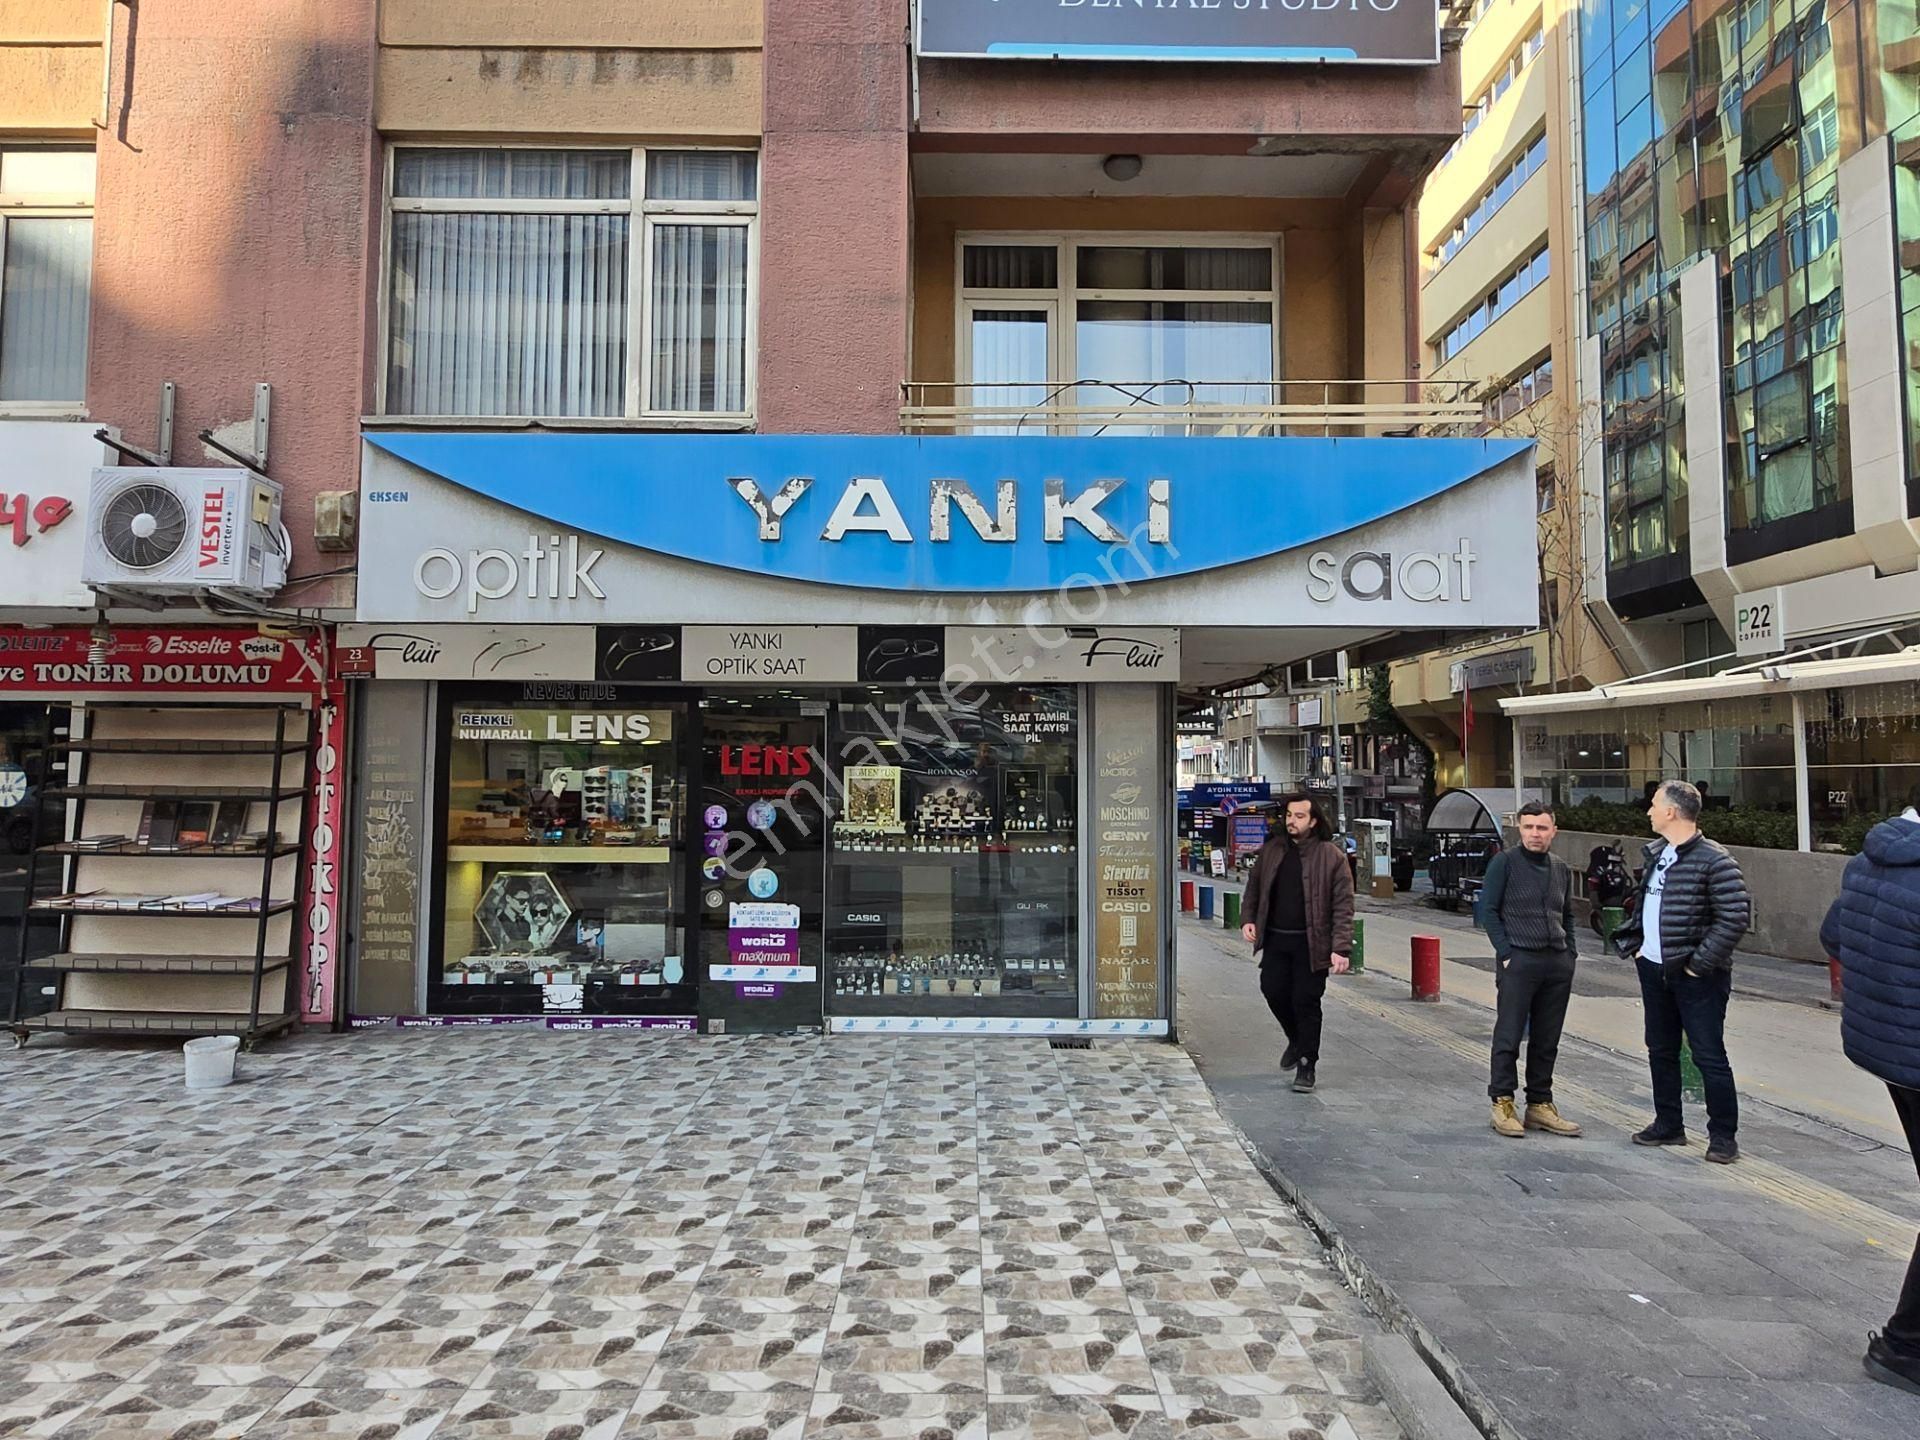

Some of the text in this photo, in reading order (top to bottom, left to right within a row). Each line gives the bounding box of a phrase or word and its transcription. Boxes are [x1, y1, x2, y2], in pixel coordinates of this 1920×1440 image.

[368, 491, 408, 502] EKSEN
[726, 477, 1171, 543] YANKI
[199, 487, 224, 568] VESTEL
[413, 535, 607, 614] optik
[1306, 537, 1477, 603] saat
[1738, 604, 1771, 632] P22
[729, 632, 782, 650] YANKI
[1739, 629, 1772, 642] COFFEE
[164, 636, 232, 655] Esselte
[244, 643, 281, 654] Post-it
[350, 649, 362, 660] 23
[1080, 637, 1164, 668] Flair
[706, 654, 807, 675] OPTİK SAAT
[34, 663, 134, 683] TONER
[142, 664, 272, 684] DOLUMU
[523, 682, 576, 700] NEVER
[1002, 710, 1071, 723] SAAT TAMİRİ
[546, 714, 651, 741] LENS
[1003, 723, 1069, 734] SAAT KAYIŞI
[459, 729, 533, 741] NUMARALI
[1025, 732, 1042, 743] PİL
[720, 744, 812, 776] LENS
[927, 768, 978, 778] ROMANSON
[1828, 791, 1848, 803] P22
[1100, 806, 1151, 821] MOSCHINO
[1102, 831, 1151, 842] GENNY
[1106, 888, 1146, 897] TISSOT
[1101, 902, 1151, 913] CASIO
[847, 913, 881, 922] CASIO
[741, 938, 786, 947] WORLD
[738, 951, 790, 964] maximum
[1100, 957, 1151, 966] NACAR
